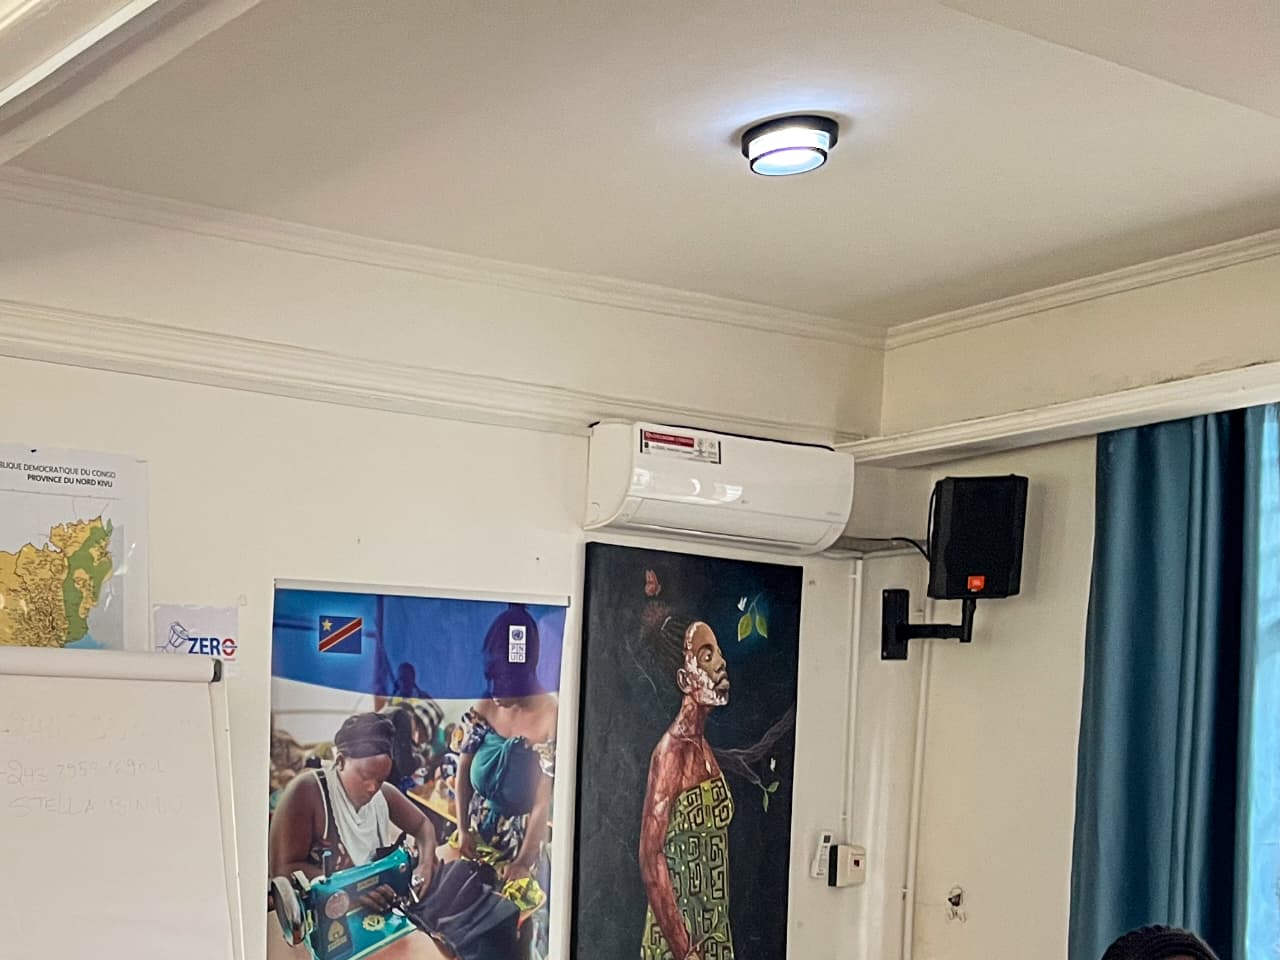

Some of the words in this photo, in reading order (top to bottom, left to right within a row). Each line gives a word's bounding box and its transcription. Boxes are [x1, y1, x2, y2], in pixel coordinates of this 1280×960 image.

[23, 463, 78, 475] DEMOCRATIQUE
[80, 468, 90, 476] DU
[91, 470, 116, 479] CONGO
[27, 474, 62, 483] PROVINCE
[64, 476, 74, 484] DU
[76, 477, 96, 486] NORD
[97, 479, 113, 488] KIVU
